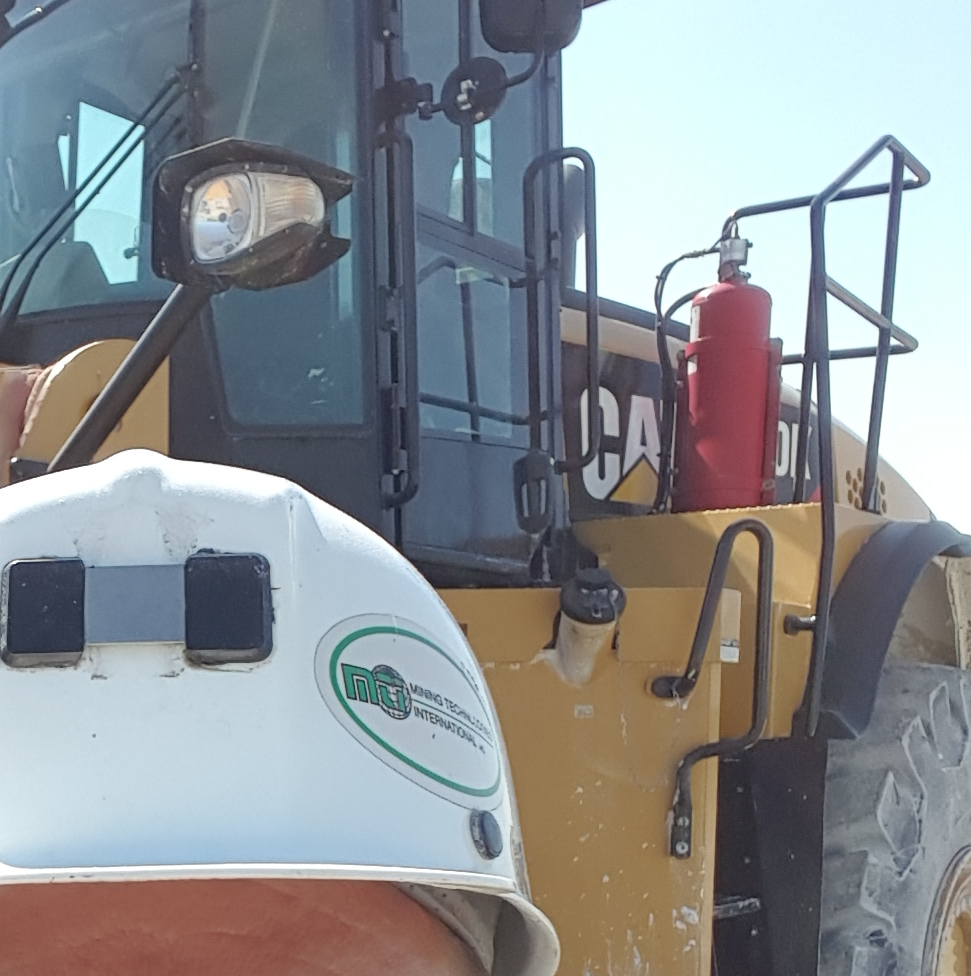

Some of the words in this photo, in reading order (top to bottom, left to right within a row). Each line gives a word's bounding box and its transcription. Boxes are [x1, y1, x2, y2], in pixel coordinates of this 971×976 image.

[580, 385, 677, 501] CA
[409, 682, 443, 706] MINING
[413, 706, 477, 748] INTERNATIONAL
